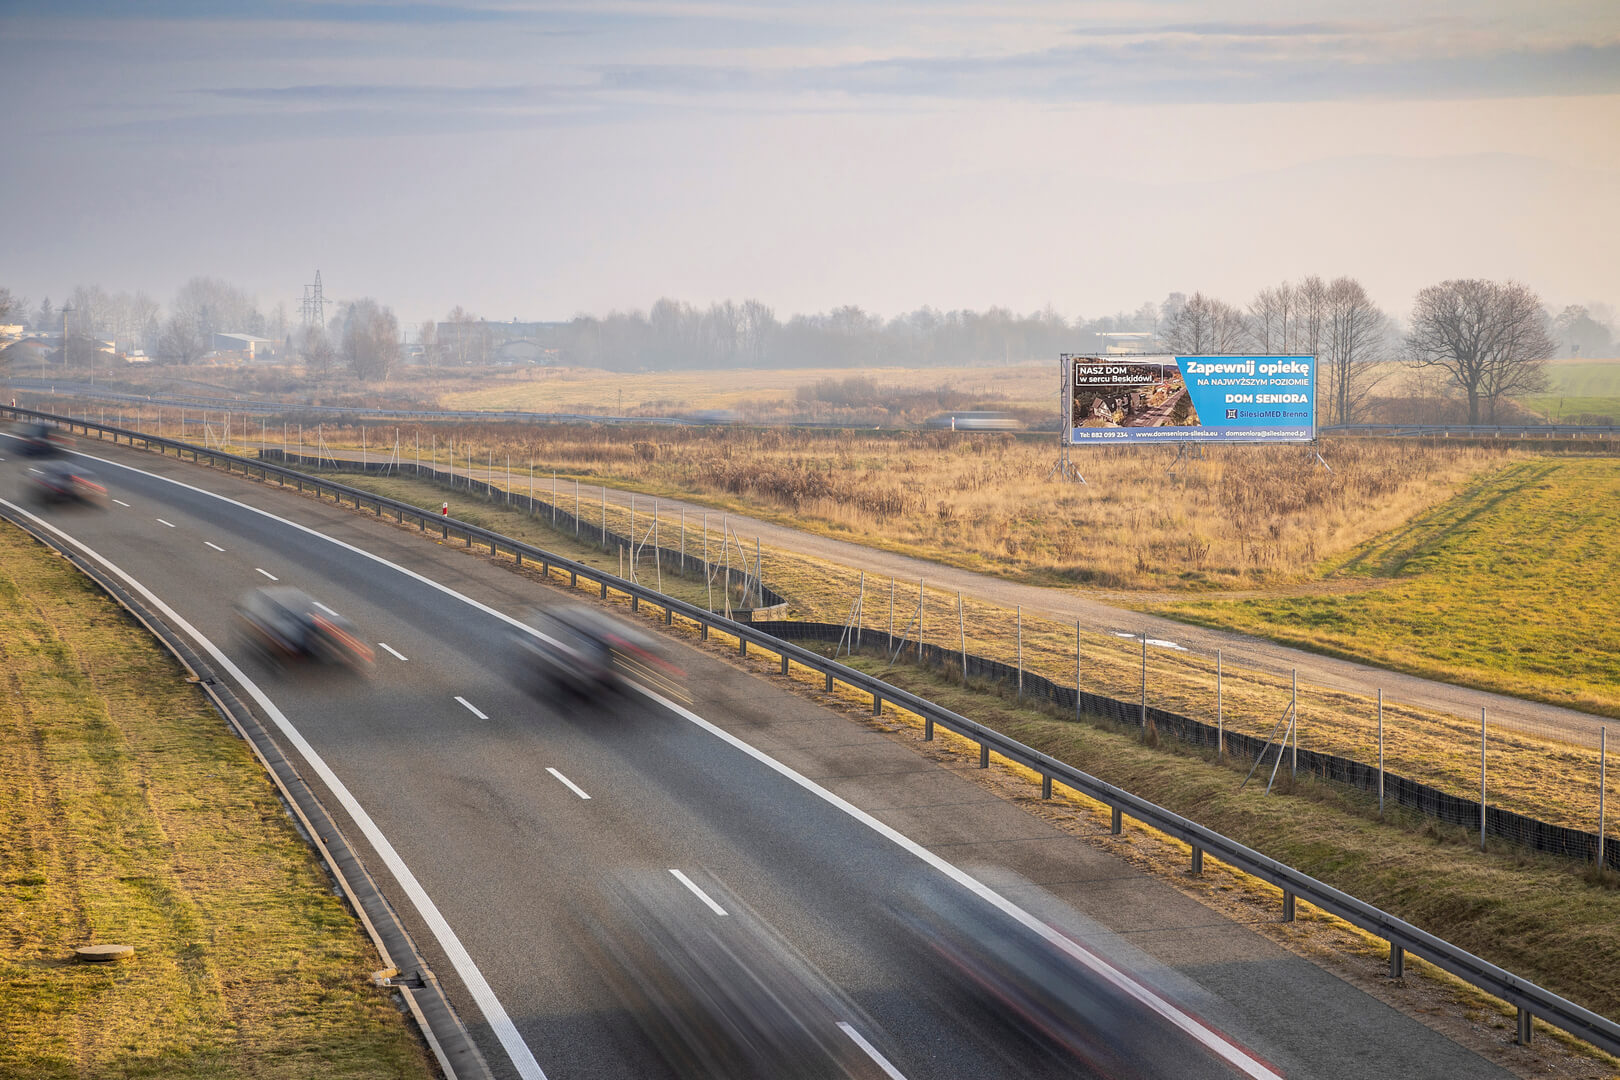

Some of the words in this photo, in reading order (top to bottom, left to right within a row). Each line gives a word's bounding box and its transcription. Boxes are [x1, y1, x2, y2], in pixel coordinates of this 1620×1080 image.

[1187, 360, 1255, 376] Zapewnij
[1259, 360, 1309, 376] opiekę
[1211, 377, 1267, 386] NAJWYŻSZYM
[1270, 378, 1309, 386] POZIOMIE
[1225, 394, 1253, 403] DOM
[1256, 394, 1308, 403] SENIORA
